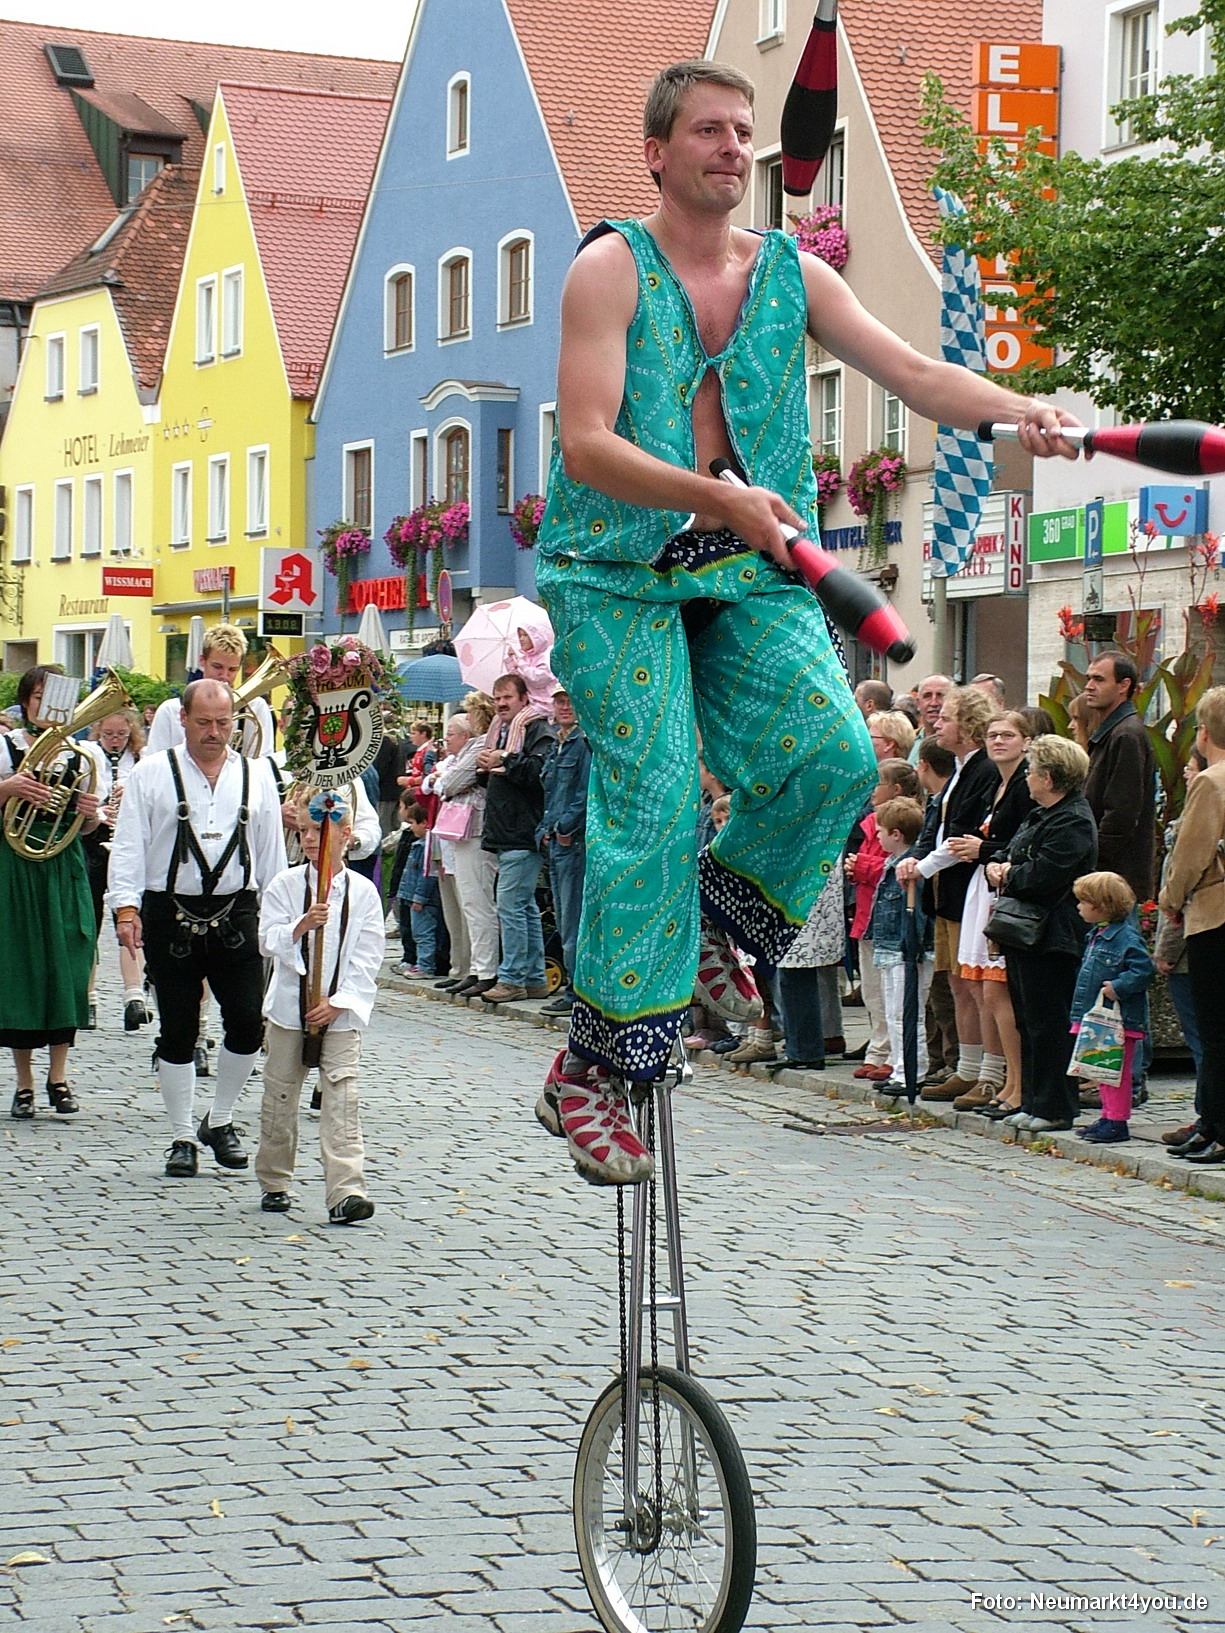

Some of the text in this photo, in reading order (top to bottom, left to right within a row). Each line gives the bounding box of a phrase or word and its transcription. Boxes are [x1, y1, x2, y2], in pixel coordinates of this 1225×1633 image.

[64, 434, 99, 467] HOTEL
[1010, 497, 1022, 588] KINO
[1043, 518, 1060, 544] 360
[1087, 510, 1099, 558] P
[105, 577, 151, 588] WISSMACH
[59, 594, 109, 616] Restaurant
[314, 774, 333, 787] DER
[336, 706, 383, 786] MARKTGEMEINDE
